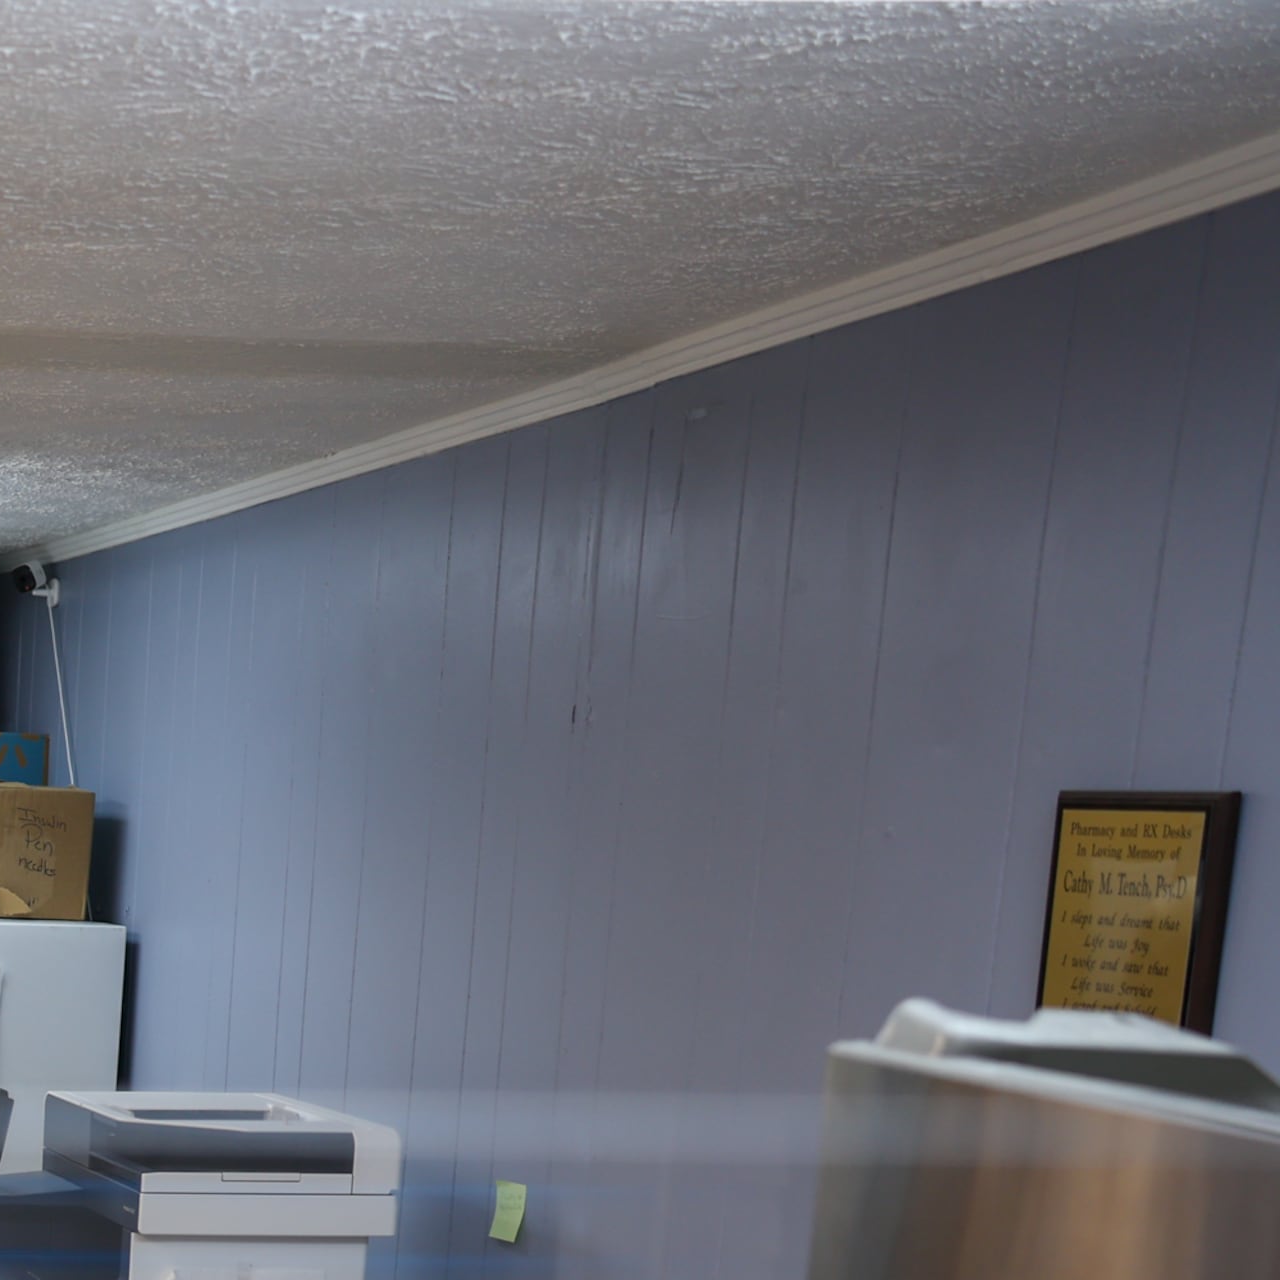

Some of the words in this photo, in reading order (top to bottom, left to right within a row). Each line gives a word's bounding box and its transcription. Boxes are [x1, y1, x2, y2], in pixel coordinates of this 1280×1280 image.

[1071, 822, 1115, 840] Pharmacy
[1121, 824, 1138, 838] and
[1143, 824, 1158, 838] RX
[1162, 824, 1192, 839] Desks
[1077, 843, 1086, 856] In
[1092, 844, 1122, 860] Loving
[1126, 844, 1166, 862] Memory
[1170, 846, 1182, 860] of
[1064, 870, 1094, 898] Cathy
[1098, 872, 1113, 895] M.
[1072, 910, 1092, 929] slept
[1098, 912, 1116, 926] and
[1158, 915, 1180, 931] that
[1083, 934, 1104, 951] Life
[1108, 940, 1127, 950] was
[1072, 956, 1096, 972] woke
[1099, 958, 1120, 972] and
[1121, 964, 1144, 974] saw
[1148, 961, 1169, 976] that
[1070, 976, 1092, 995] Life
[1096, 982, 1115, 993] was
[1118, 982, 1154, 998] Service
